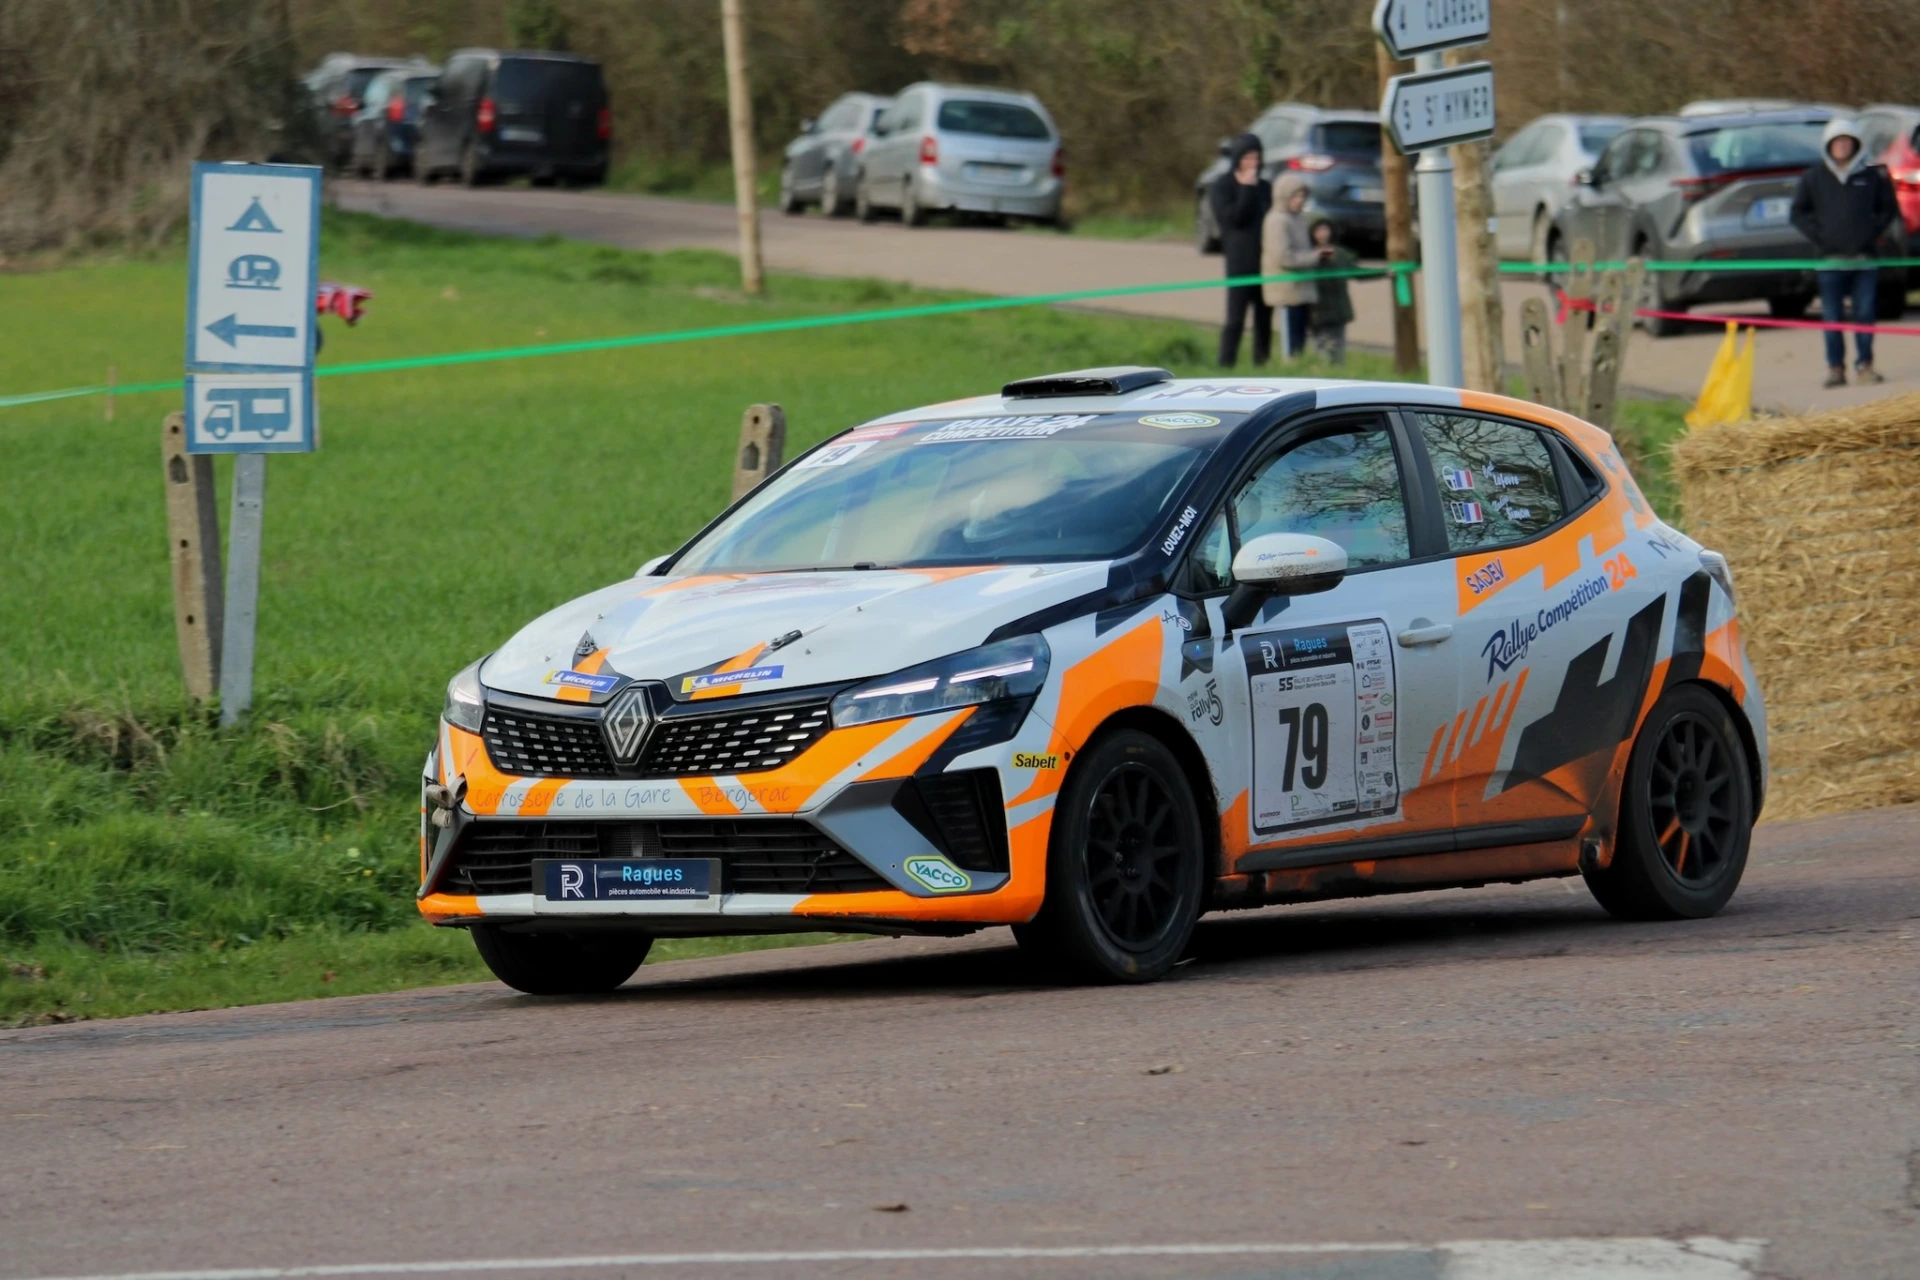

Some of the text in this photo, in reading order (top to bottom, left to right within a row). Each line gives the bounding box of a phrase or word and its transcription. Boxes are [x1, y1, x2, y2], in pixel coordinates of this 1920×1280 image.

[1153, 416, 1208, 425] YACCO
[1161, 505, 1198, 557] LOUEZ-MOI
[1466, 558, 1504, 594] SADEV
[1481, 552, 1637, 685] Rallye Compétition 24
[1293, 637, 1328, 653] Ragues
[563, 674, 606, 687] MICHELIN
[710, 669, 773, 684] MICHELIN
[1278, 676, 1294, 691] 55
[1279, 703, 1328, 792] 79
[1015, 754, 1057, 769] Sabelt
[476, 785, 791, 811] Carrosserie de la Gare Bergerac
[622, 866, 683, 885] Ragues
[914, 862, 963, 886] YACCO
[608, 887, 628, 896] pièces
[628, 887, 661, 895] automobile
[669, 887, 696, 895] industrie
